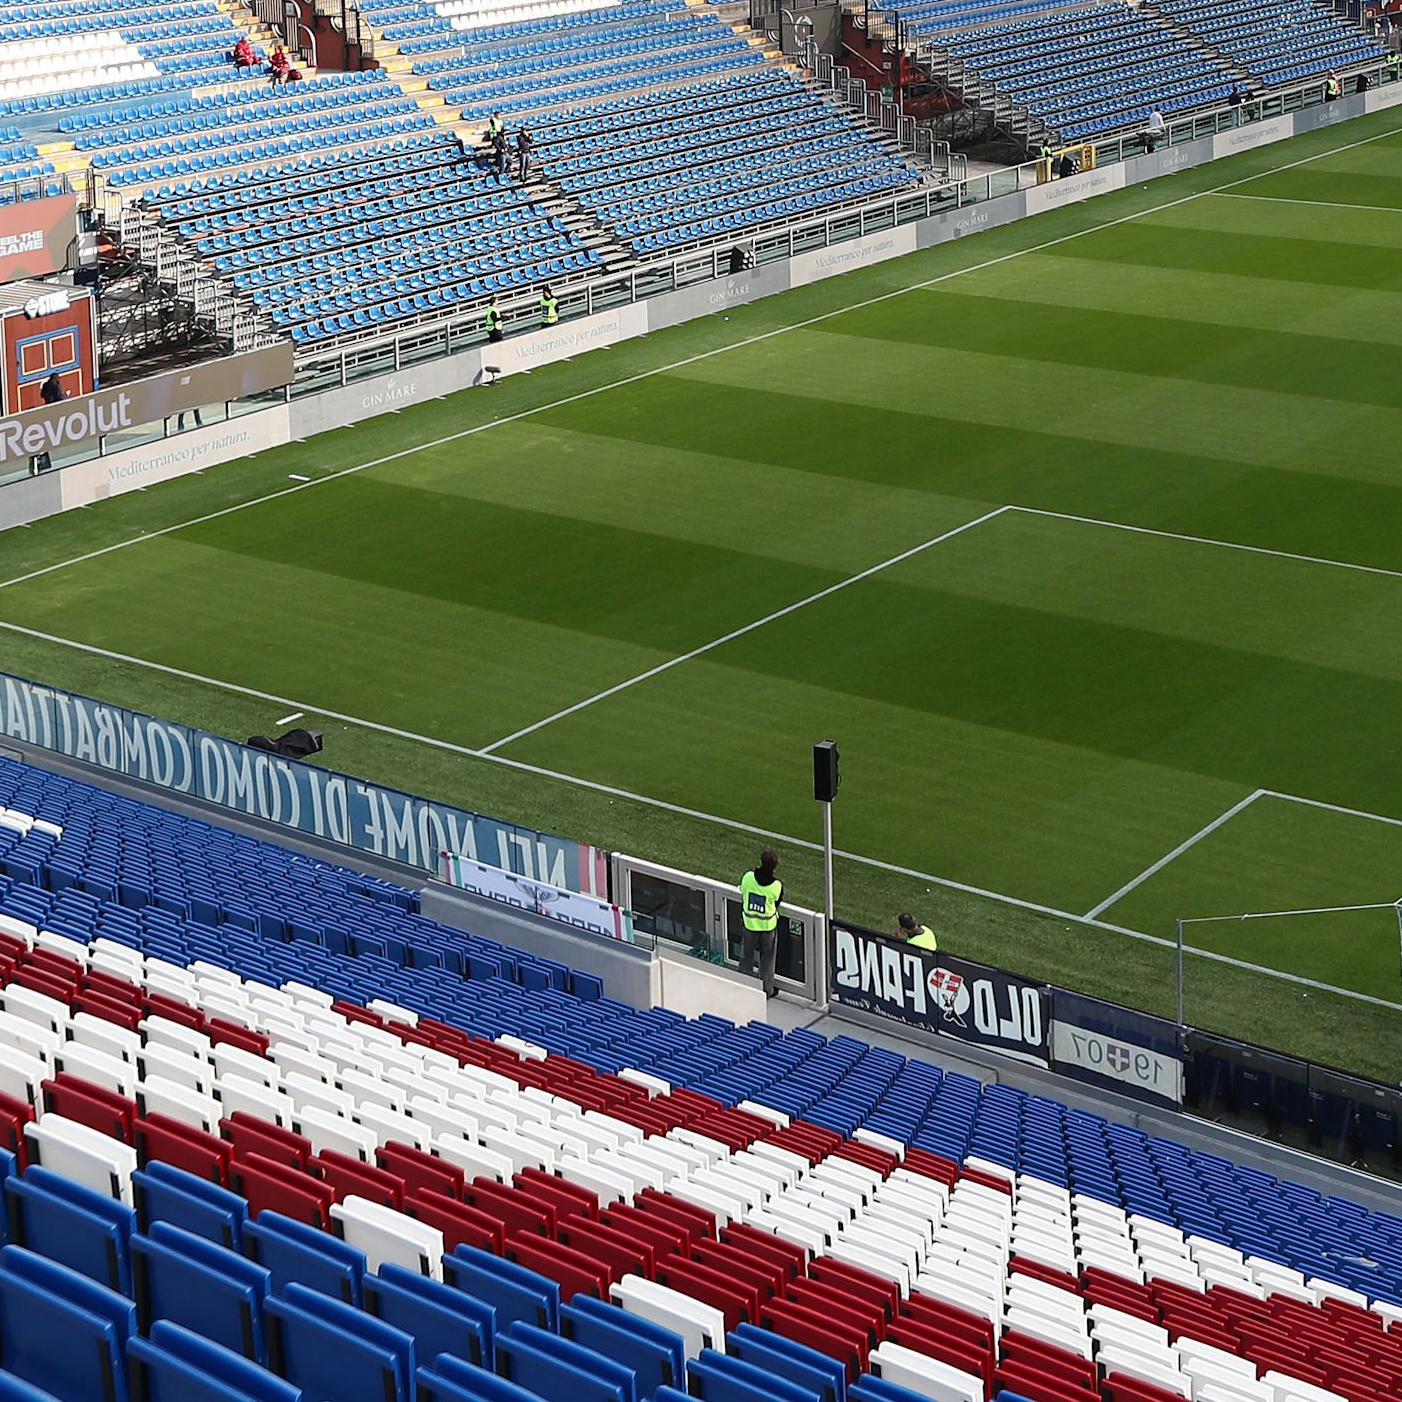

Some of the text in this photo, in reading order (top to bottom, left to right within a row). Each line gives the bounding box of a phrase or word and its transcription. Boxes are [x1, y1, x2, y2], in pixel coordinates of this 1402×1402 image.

[19, 229, 43, 243] THE
[362, 383, 418, 408] GIN MARE
[108, 448, 188, 482] Mediterraneo
[191, 441, 210, 464] per
